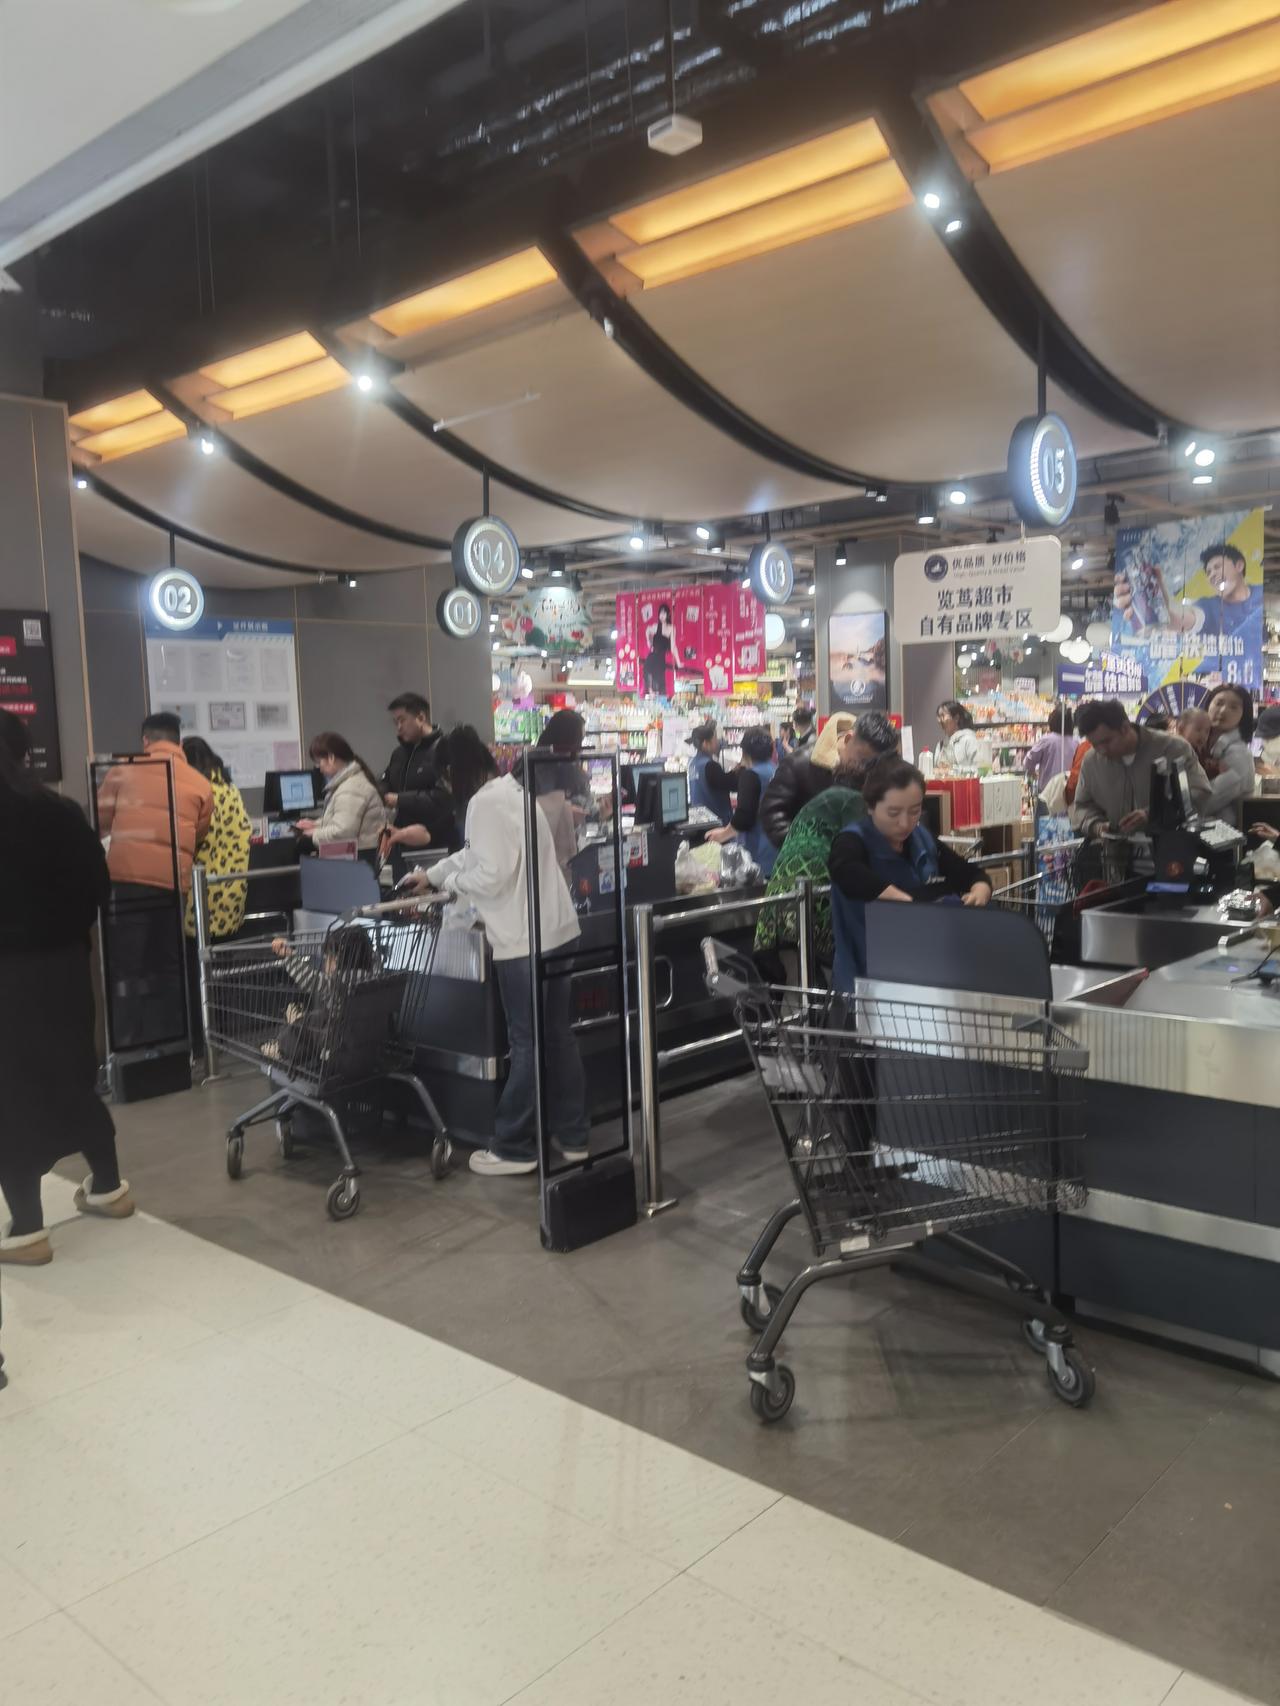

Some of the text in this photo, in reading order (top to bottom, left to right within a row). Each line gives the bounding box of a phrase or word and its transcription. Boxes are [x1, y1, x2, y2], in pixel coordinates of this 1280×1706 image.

[1042, 447, 1066, 494] 05
[477, 539, 505, 574] 04
[992, 550, 1026, 566] 好价格
[768, 560, 787, 587] 03
[163, 584, 192, 614] 02
[453, 601, 472, 625] 01
[920, 607, 1033, 637] 自有品牌专区
